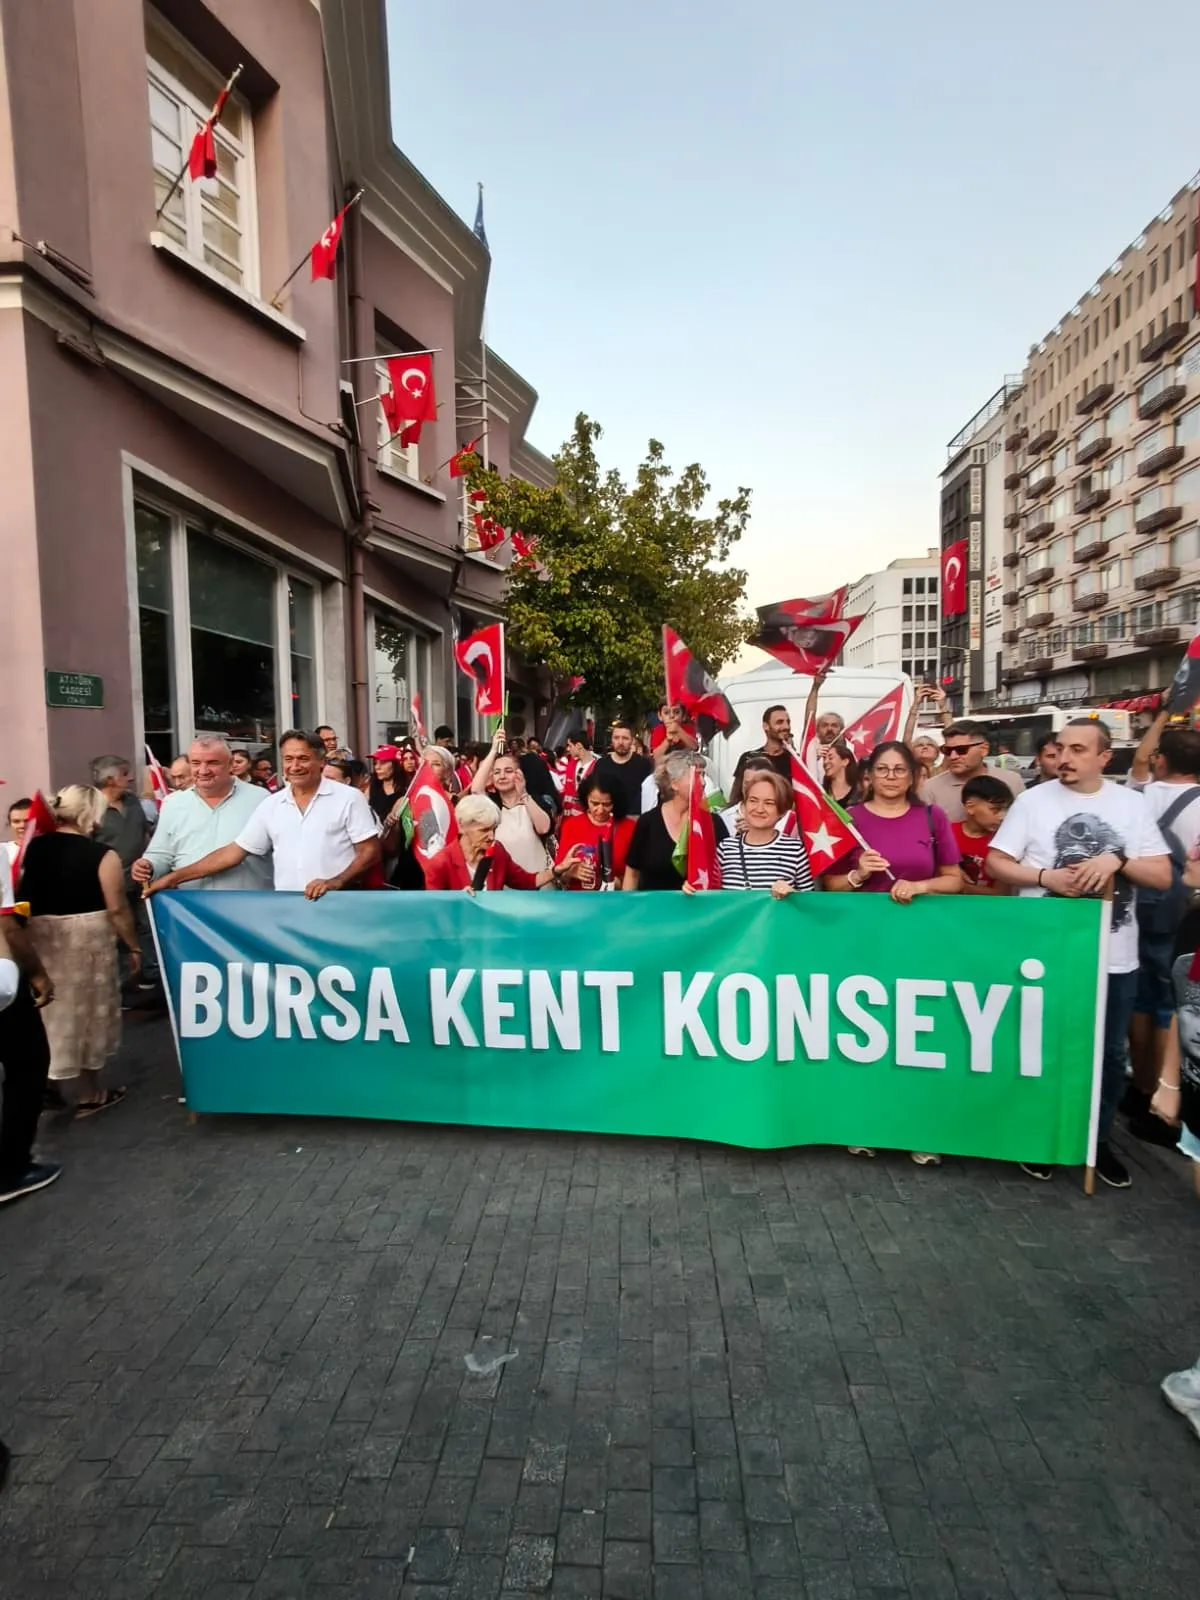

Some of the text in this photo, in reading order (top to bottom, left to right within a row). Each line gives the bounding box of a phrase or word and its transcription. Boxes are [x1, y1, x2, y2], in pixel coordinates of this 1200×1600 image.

[180, 958, 1045, 1077] BURSA KENT KONSEYİ
